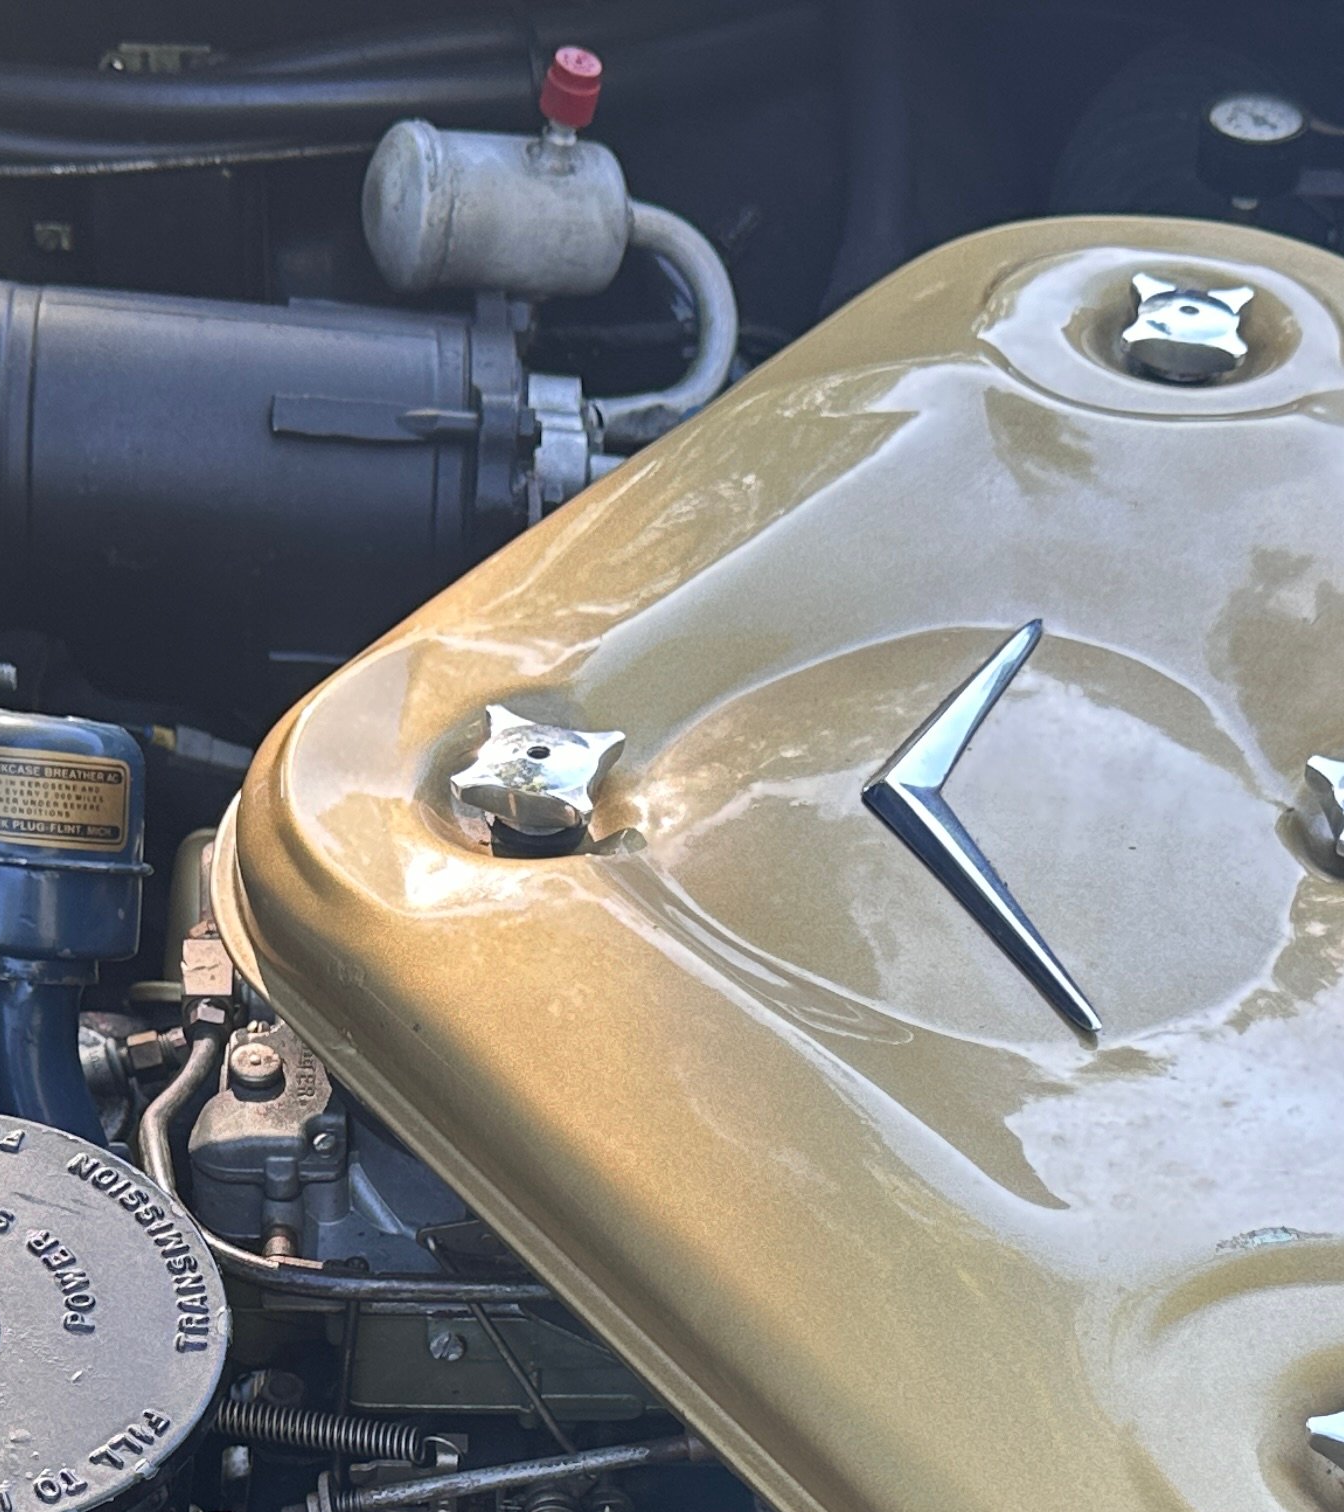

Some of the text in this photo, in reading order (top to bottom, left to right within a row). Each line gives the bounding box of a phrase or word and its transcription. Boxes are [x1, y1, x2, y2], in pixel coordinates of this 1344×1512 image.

[44, 767, 105, 782] BREATHER
[27, 1228, 97, 1335] POWER
[68, 1151, 210, 1354] TRANSMISSION
[88, 1408, 172, 1472] FILL
[32, 1467, 90, 1503] TO
